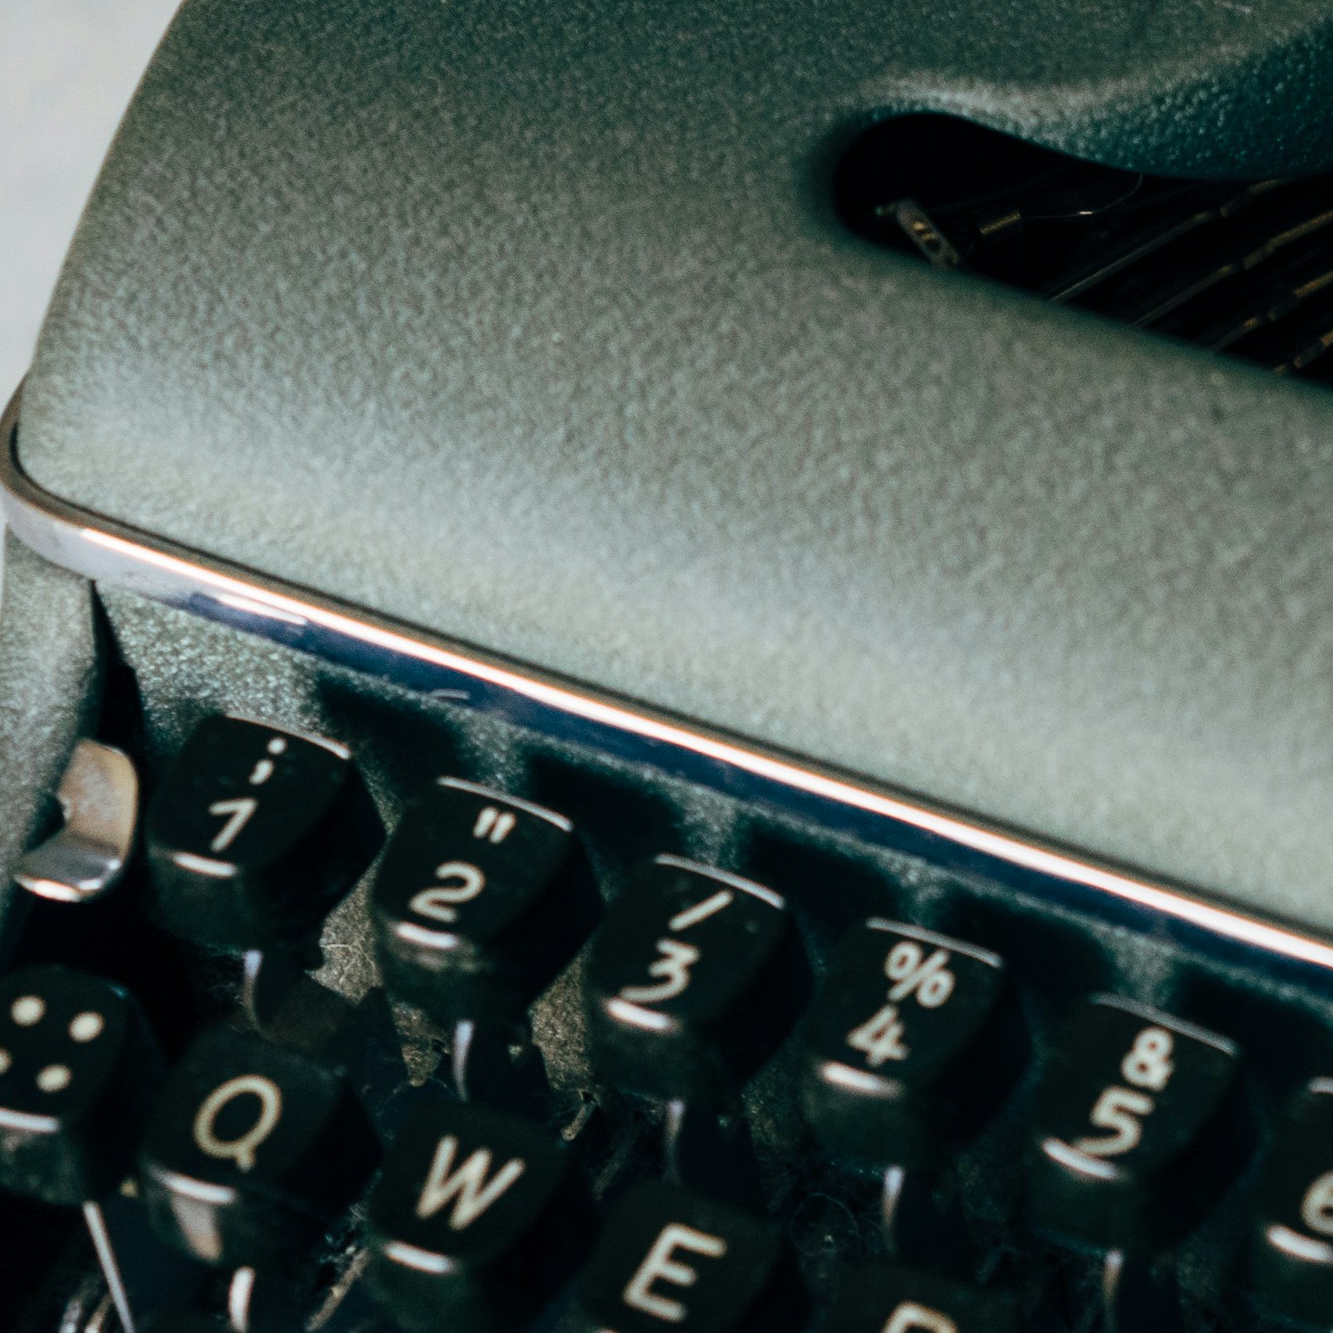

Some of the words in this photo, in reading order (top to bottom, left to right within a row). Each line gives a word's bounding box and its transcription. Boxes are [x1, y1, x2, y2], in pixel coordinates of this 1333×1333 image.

[208, 797, 258, 853] 1
[409, 861, 486, 923] 2
[621, 938, 700, 1004] 3
[884, 941, 956, 1009] %
[847, 1004, 908, 1066] 4
[194, 1074, 282, 1170] Q
[1072, 1085, 1154, 1156] 5
[416, 1135, 525, 1229] W
[624, 1223, 726, 1322] E
